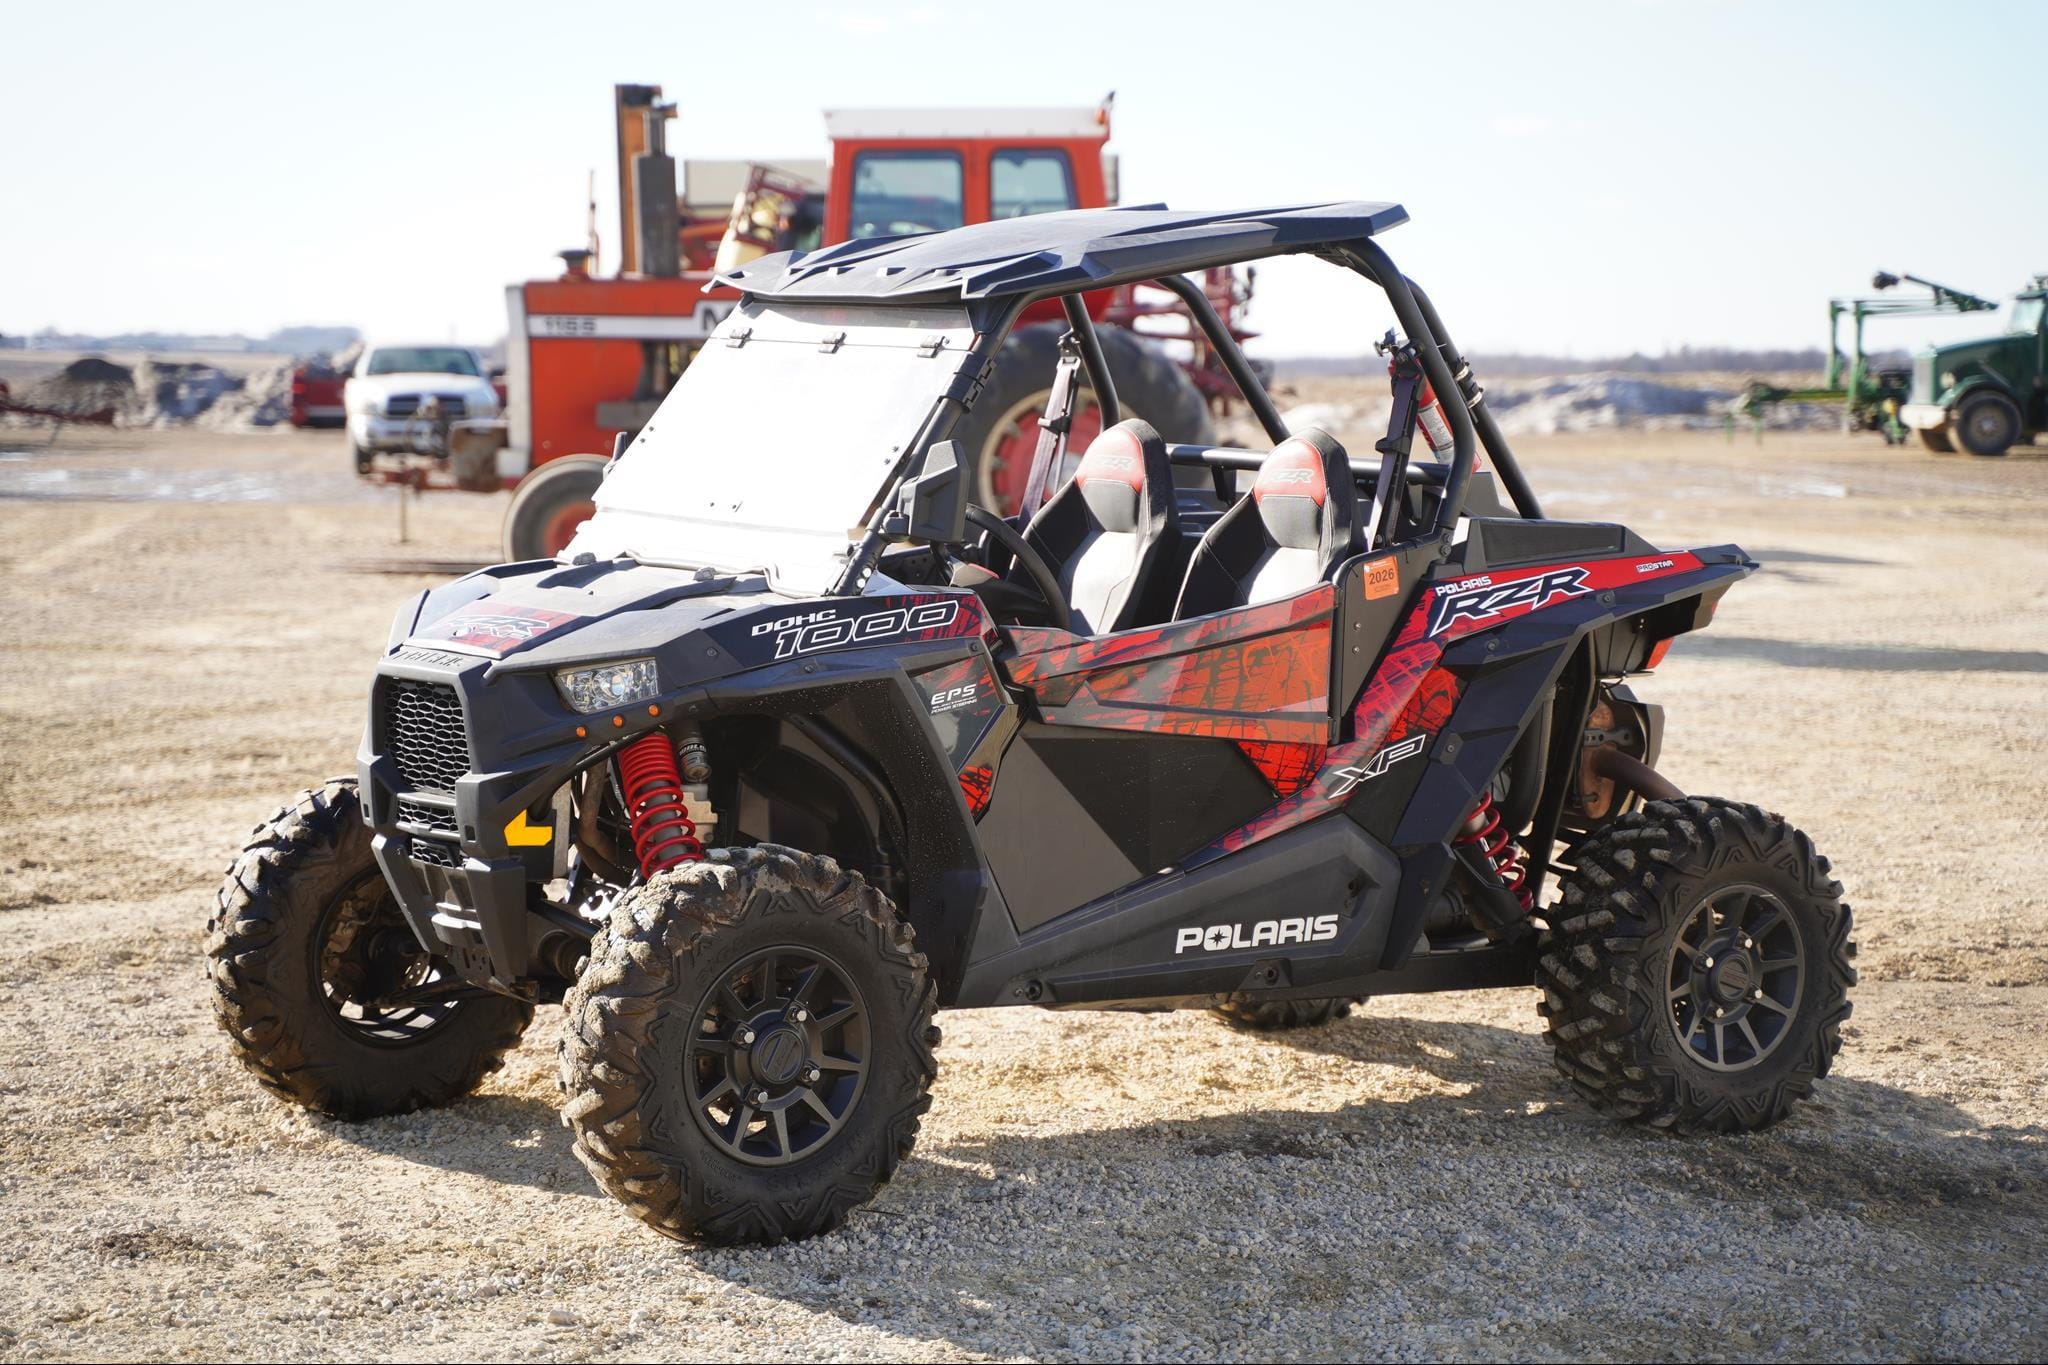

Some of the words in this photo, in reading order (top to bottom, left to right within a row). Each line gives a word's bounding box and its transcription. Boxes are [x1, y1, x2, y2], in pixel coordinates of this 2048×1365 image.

[1368, 568, 1395, 585] 2026
[1435, 575, 1493, 597] POLARIS
[1429, 566, 1595, 638] RZR
[751, 609, 836, 637] DOHC
[774, 600, 959, 660] 1000
[931, 683, 977, 705] EPS
[1328, 734, 1426, 799] XP
[1175, 914, 1339, 954] POLARIS
